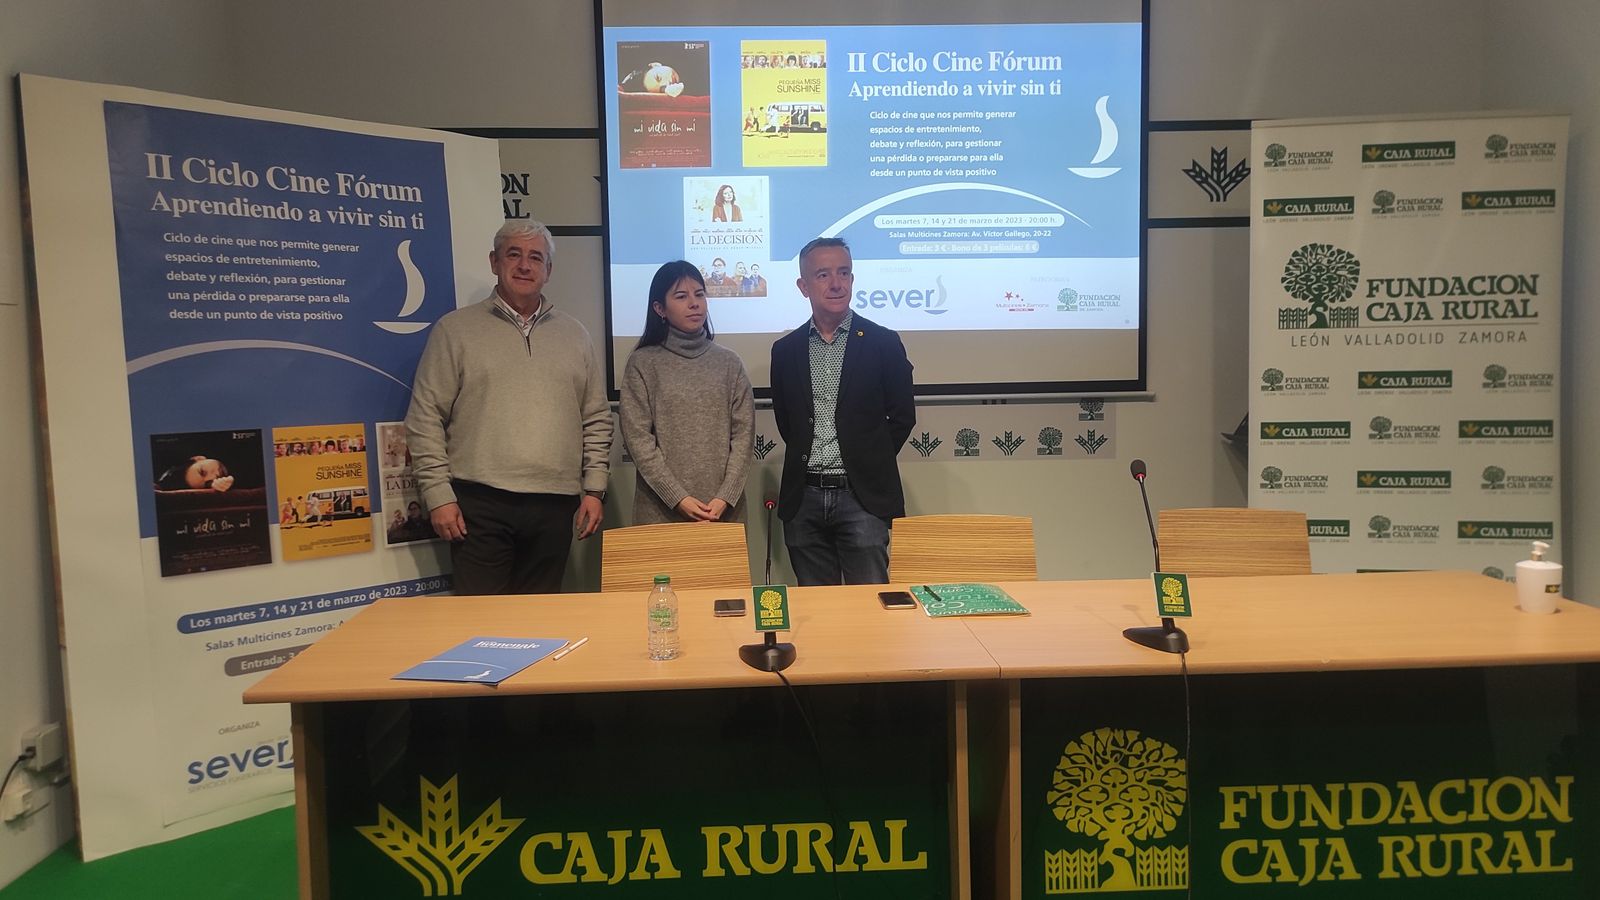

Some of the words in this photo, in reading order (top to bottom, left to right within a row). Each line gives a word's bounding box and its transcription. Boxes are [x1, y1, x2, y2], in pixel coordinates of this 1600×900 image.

[847, 52, 866, 72] II
[872, 51, 927, 72] Ciclo
[932, 51, 982, 72] Cine
[987, 50, 1062, 71] Fórum
[776, 84, 821, 93] SUNSHINE
[848, 80, 958, 101] Aprendiendo
[962, 84, 972, 96] a
[977, 79, 1016, 95] vivir
[1020, 79, 1044, 95] sin
[1049, 79, 1060, 95] ti
[869, 110, 888, 119] Ciclo
[890, 110, 900, 119] de
[902, 110, 918, 118] cine
[919, 112, 935, 120] que
[952, 110, 983, 120] permite
[985, 111, 1016, 120] generar
[869, 125, 902, 135] espacios
[904, 125, 914, 133] de
[916, 124, 982, 133] entretenimiento,
[869, 139, 897, 148] debate
[906, 139, 943, 148] reflexión,
[945, 140, 963, 149] para
[964, 138, 1002, 148] gestionar
[886, 153, 917, 164] pérdida
[926, 155, 968, 163] prepararse
[969, 154, 987, 163] para
[989, 152, 1003, 161] ella
[1383, 149, 1411, 159] CAJA
[1414, 147, 1453, 158] RURAL
[144, 152, 174, 180] II
[182, 157, 259, 187] Ciclo
[266, 166, 329, 194] Cine
[335, 172, 422, 202] Fórum
[870, 168, 893, 176] desde
[907, 169, 931, 178] punto
[932, 168, 943, 176] de
[944, 167, 963, 176] vista
[965, 167, 996, 177] positivo
[1284, 204, 1311, 213] CAJA
[1314, 202, 1352, 212] RURAL
[1484, 197, 1512, 206] CAJA
[1515, 195, 1553, 205] RURAL
[151, 191, 302, 221] Aprendiendo
[308, 208, 321, 222] a
[326, 206, 373, 226] vivir
[378, 209, 406, 228] sin
[410, 212, 424, 229] ti
[163, 232, 191, 243] Ciclo
[193, 233, 208, 244] de
[210, 234, 233, 245] cine
[236, 238, 256, 248] que
[259, 239, 278, 247] nos
[280, 240, 320, 250] permite
[321, 243, 359, 252] generar
[164, 253, 213, 264] espacios
[215, 254, 230, 263] de
[232, 255, 320, 268] entretenimiento,
[166, 270, 207, 281] debate
[208, 274, 216, 284] y
[219, 272, 271, 284] reflexión,
[273, 276, 297, 286] para
[299, 275, 346, 286] gestionar
[1365, 274, 1539, 298] FUNDACION
[192, 290, 236, 302] pérdida
[248, 294, 305, 303] prepararse
[307, 295, 330, 304] para
[332, 293, 350, 303] ella
[855, 288, 935, 309] sever
[169, 309, 203, 319] desde
[224, 311, 257, 321] punto
[259, 310, 273, 319] de
[276, 310, 301, 319] vista
[303, 310, 343, 321] positivo
[1366, 301, 1433, 323] CAJA
[1441, 298, 1538, 320] RURAL
[1291, 332, 1329, 347] LEÓN
[1344, 332, 1444, 345] VALLADOLID
[1458, 330, 1527, 344] ZAMORA
[1380, 377, 1408, 386] CAJA
[1411, 376, 1450, 385] RURAL
[1281, 428, 1308, 437] CAJA
[1311, 427, 1348, 436] RURAL
[316, 468, 363, 480] SUNSHINE
[1310, 525, 1348, 534] RURAL
[190, 618, 211, 628] Los
[214, 611, 256, 624] martes
[258, 607, 270, 617] 7,
[273, 604, 287, 615] 14
[289, 604, 297, 614] y
[300, 600, 313, 611] 21
[316, 598, 331, 608] de
[333, 593, 366, 605] marzo
[368, 590, 382, 600] de
[383, 585, 408, 597] 2023
[415, 579, 440, 592] 20:00
[205, 640, 234, 651] Salas
[237, 630, 292, 645] Multicines
[294, 622, 336, 636] Zamora:
[241, 655, 287, 670] Entrada:
[187, 740, 289, 784] sever
[1219, 776, 1573, 830] FUNDACION
[519, 828, 681, 884] CAJA
[701, 819, 927, 877] RURAL
[1220, 837, 1361, 885] CAJA
[1378, 829, 1572, 878] RURAL
